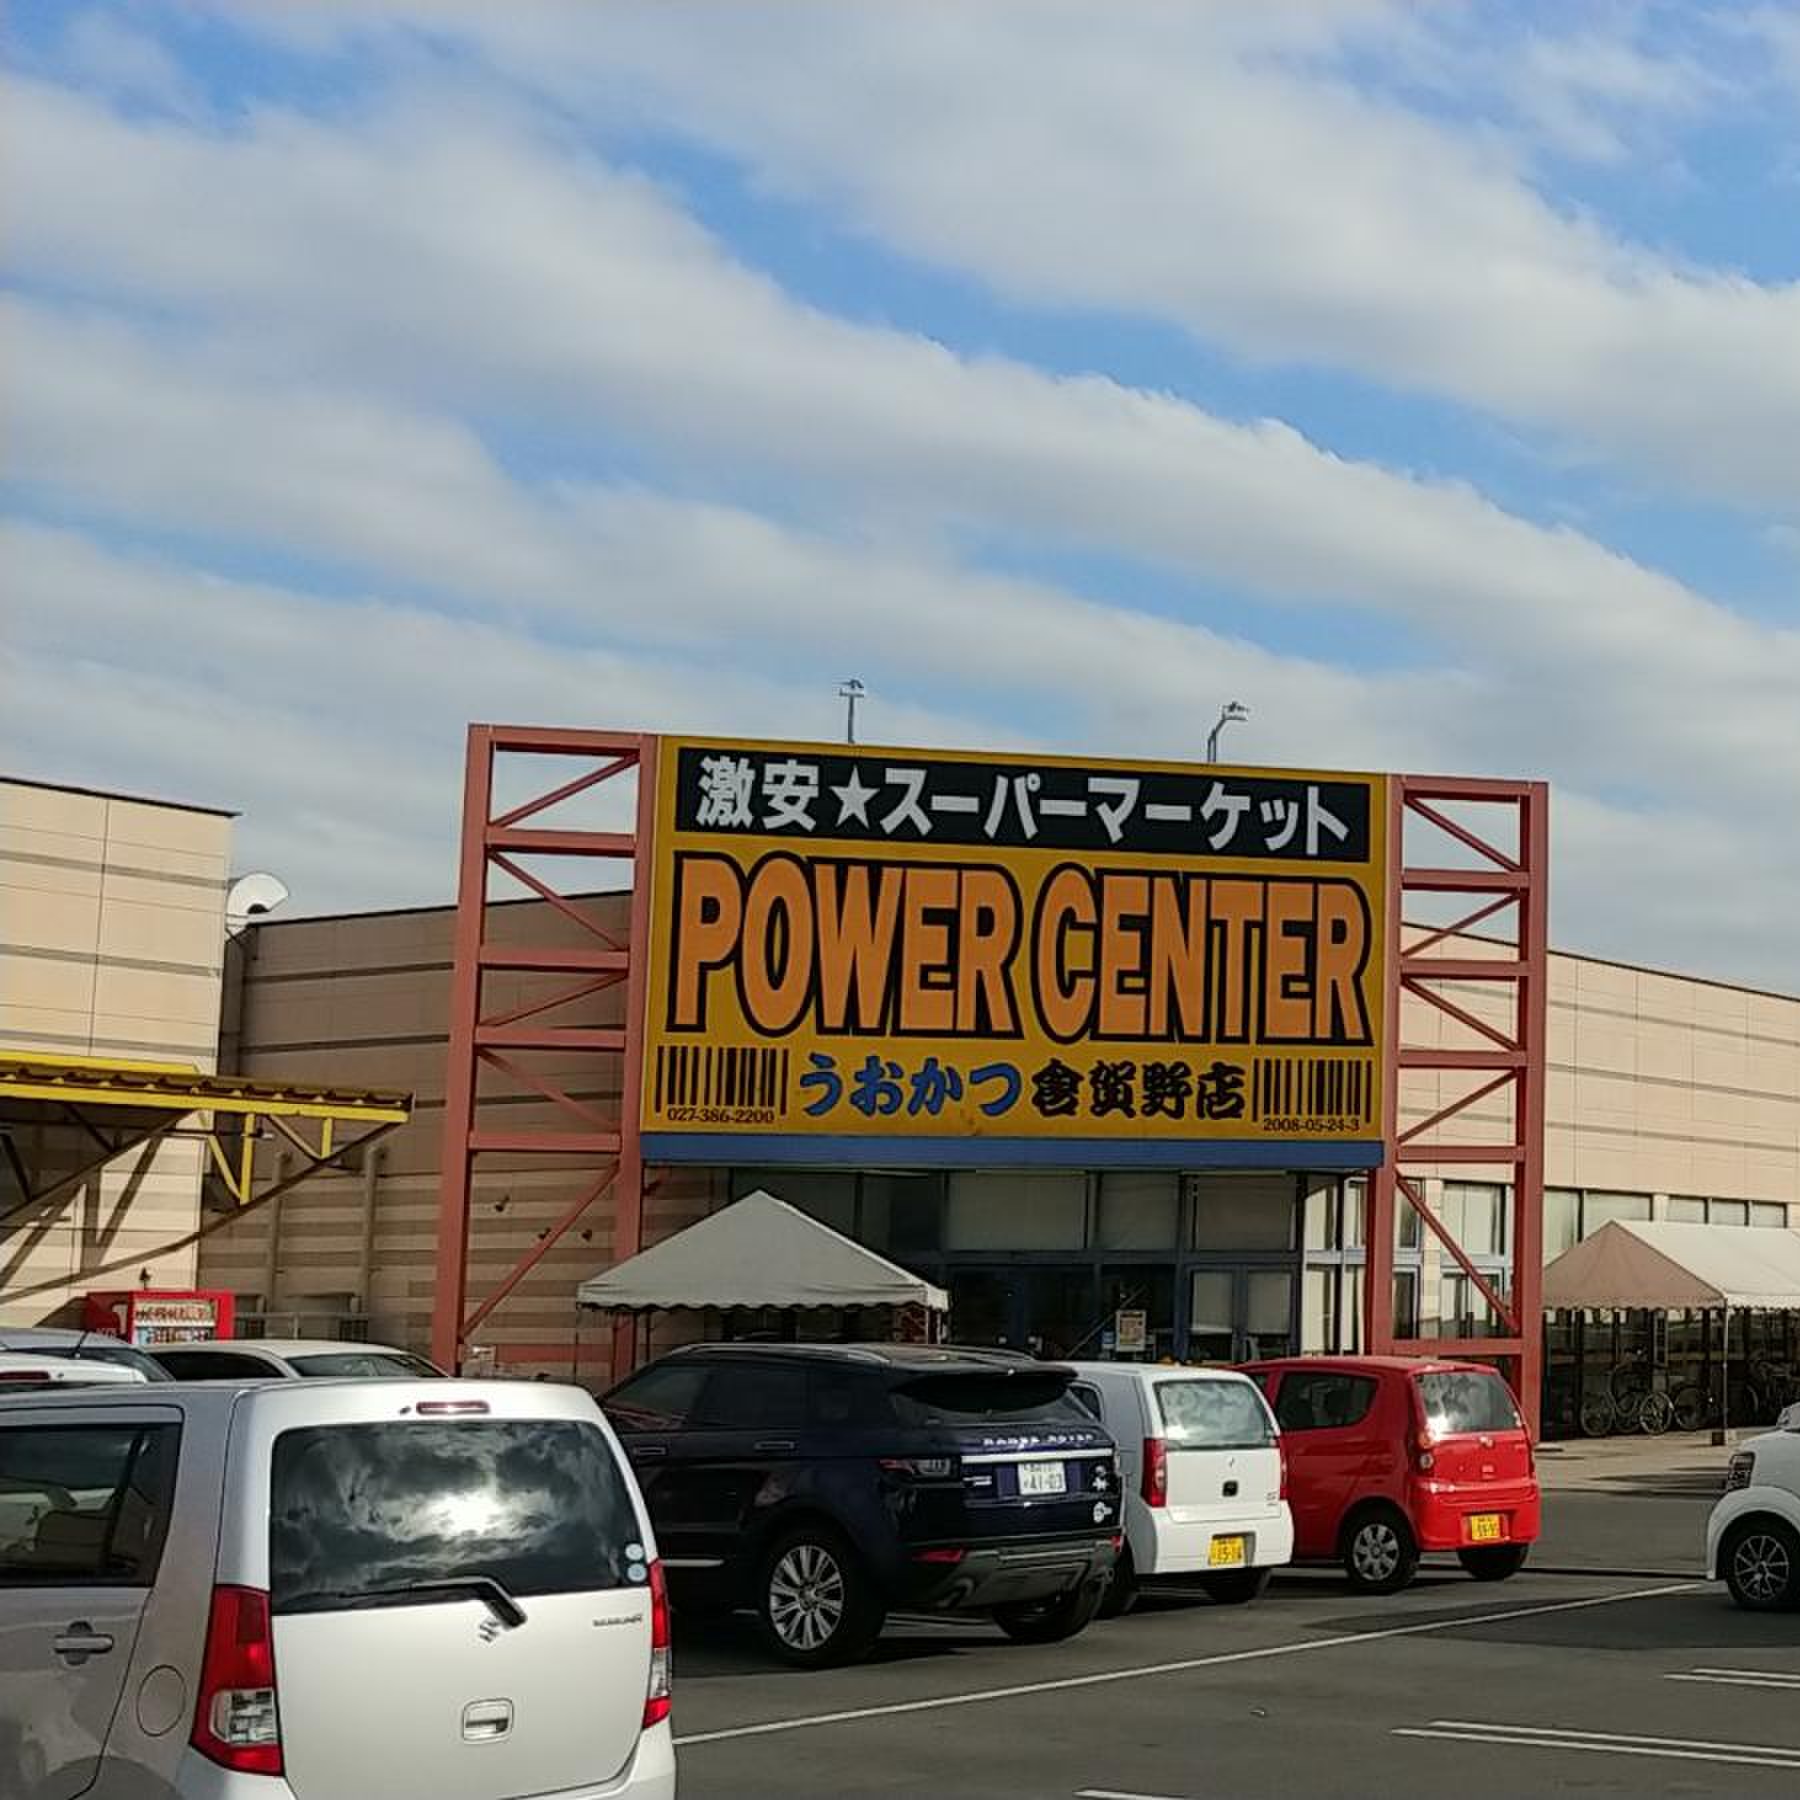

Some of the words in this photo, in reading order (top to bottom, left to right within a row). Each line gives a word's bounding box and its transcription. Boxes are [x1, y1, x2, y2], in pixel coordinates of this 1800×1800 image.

[665, 850, 1025, 1041] POWER
[1031, 862, 1375, 1046] CENTER
[667, 1107, 775, 1124] 027-386-2200
